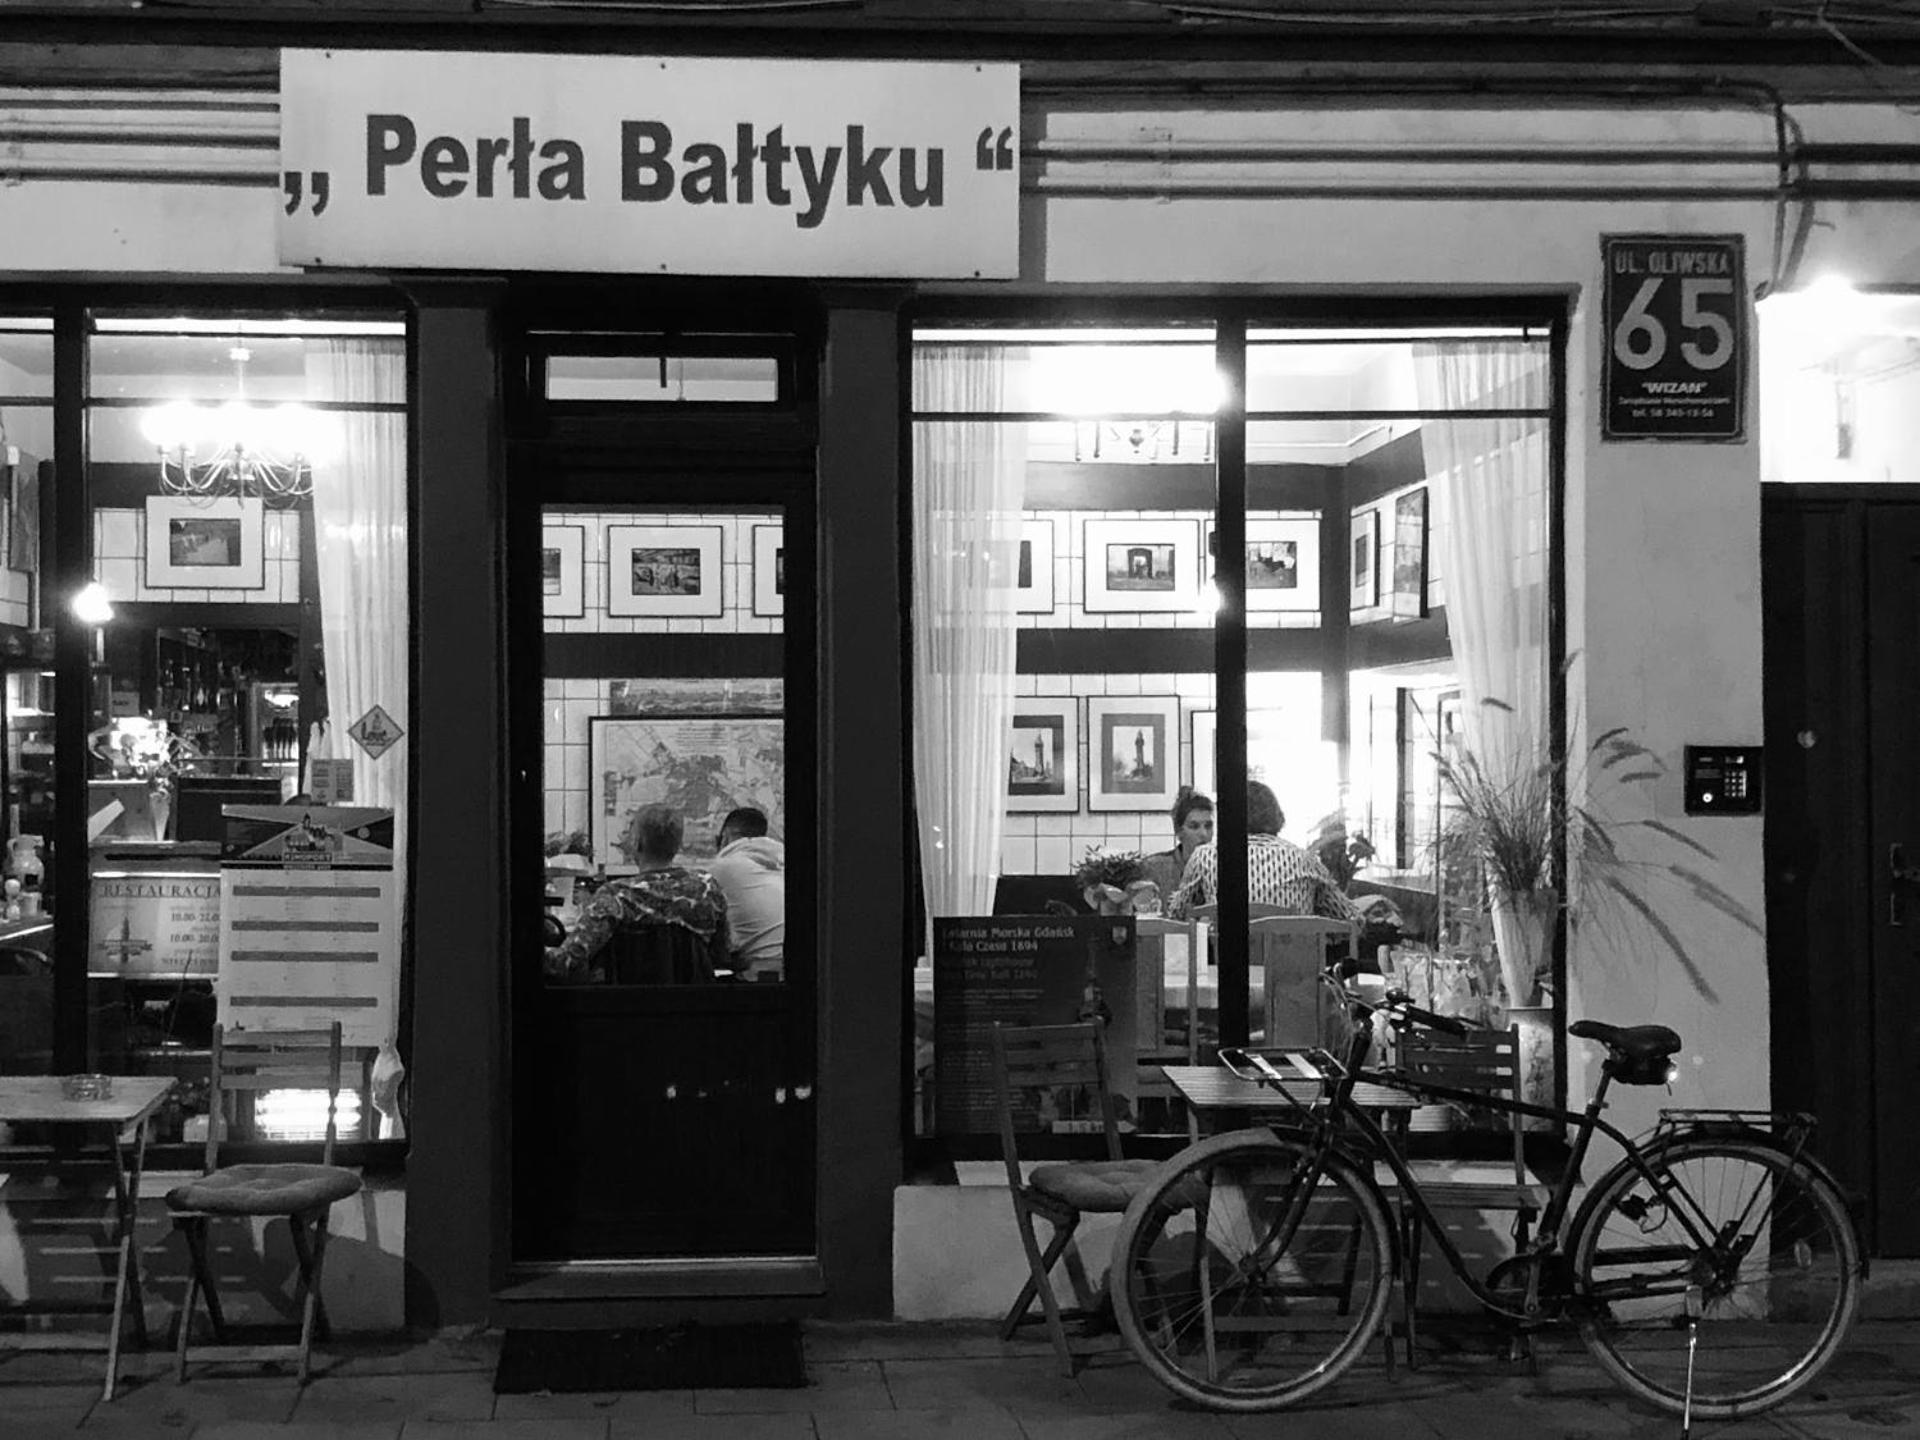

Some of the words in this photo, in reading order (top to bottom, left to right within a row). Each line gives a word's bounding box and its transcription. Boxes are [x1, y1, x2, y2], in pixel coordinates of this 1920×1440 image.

[365, 113, 587, 201] Perła
[620, 119, 945, 229] Bałtyku
[1615, 250, 1645, 274] UL.
[1648, 250, 1730, 274] OLIWSKA
[1613, 277, 1734, 370] 65
[991, 927, 1031, 939] Morska
